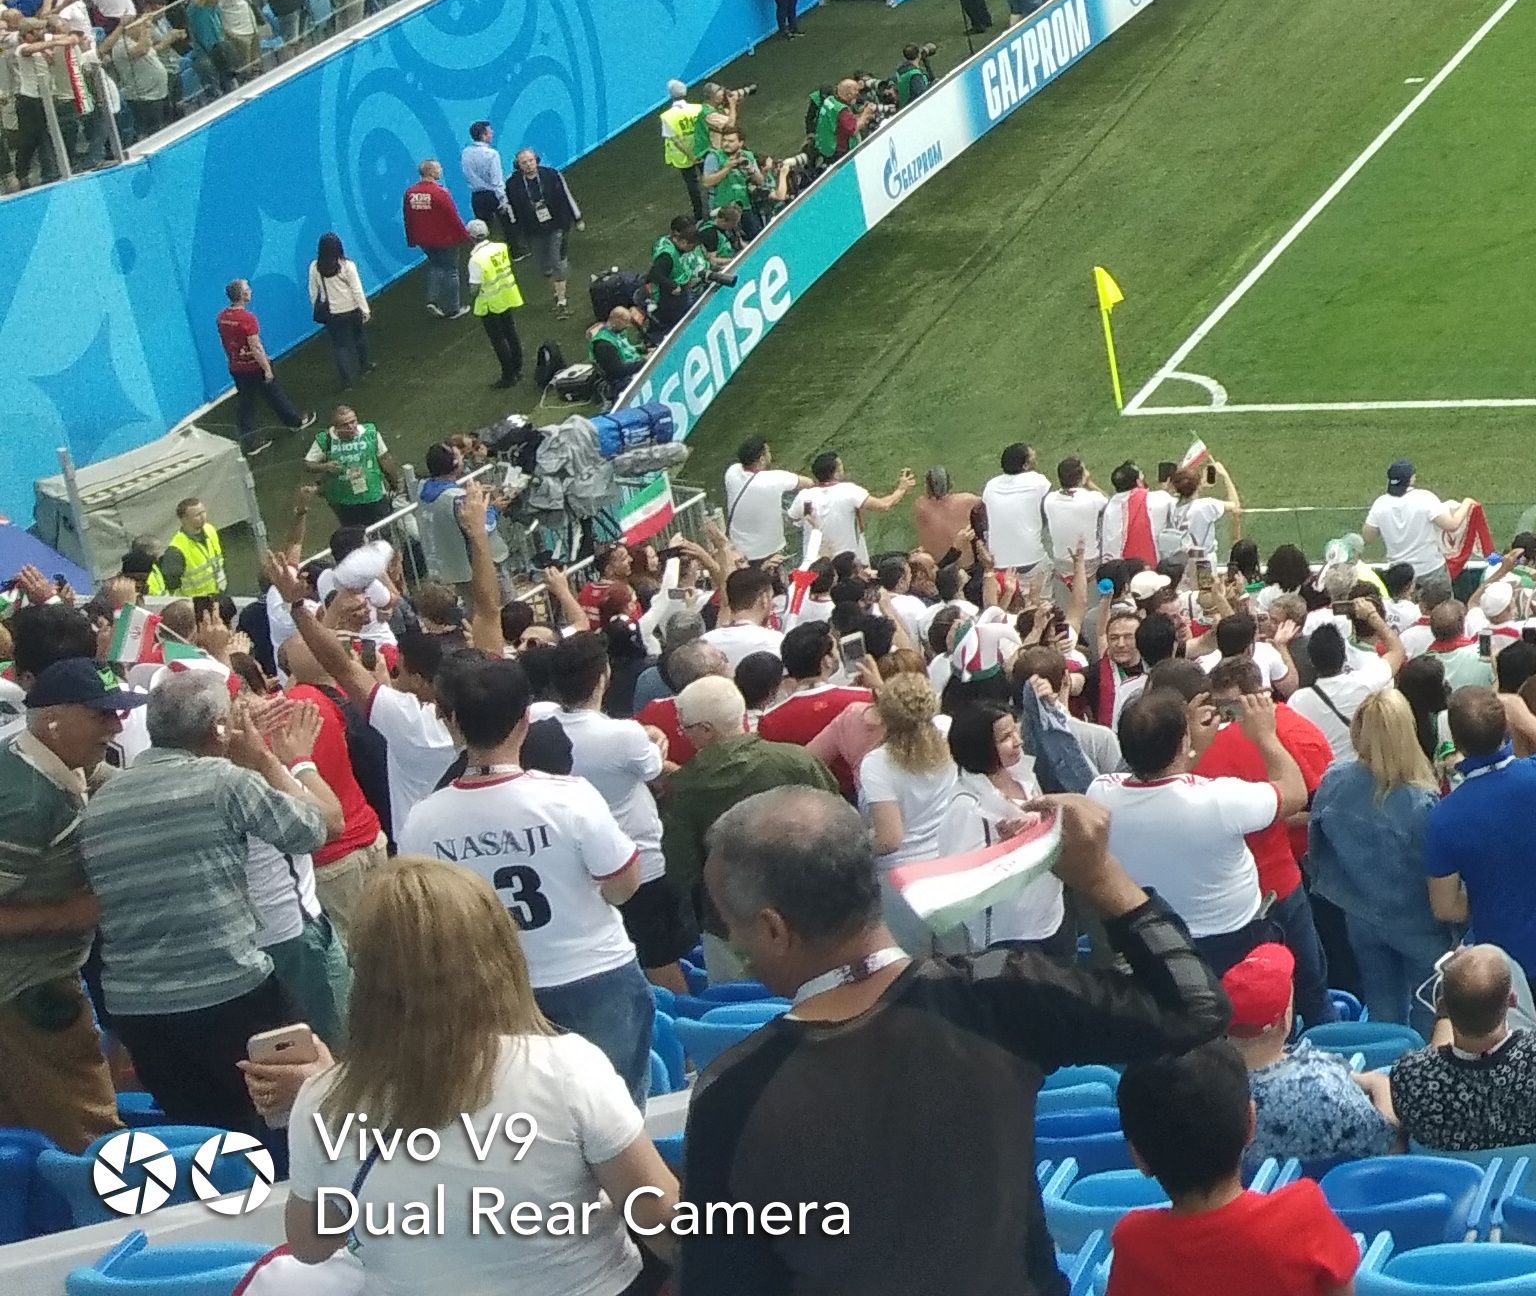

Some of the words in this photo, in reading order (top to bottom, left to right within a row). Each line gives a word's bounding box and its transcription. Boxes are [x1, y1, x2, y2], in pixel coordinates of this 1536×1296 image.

[900, 140, 943, 190] GAZPROM
[629, 255, 792, 441] sense
[433, 824, 551, 862] NASAJI
[493, 865, 552, 931] 3
